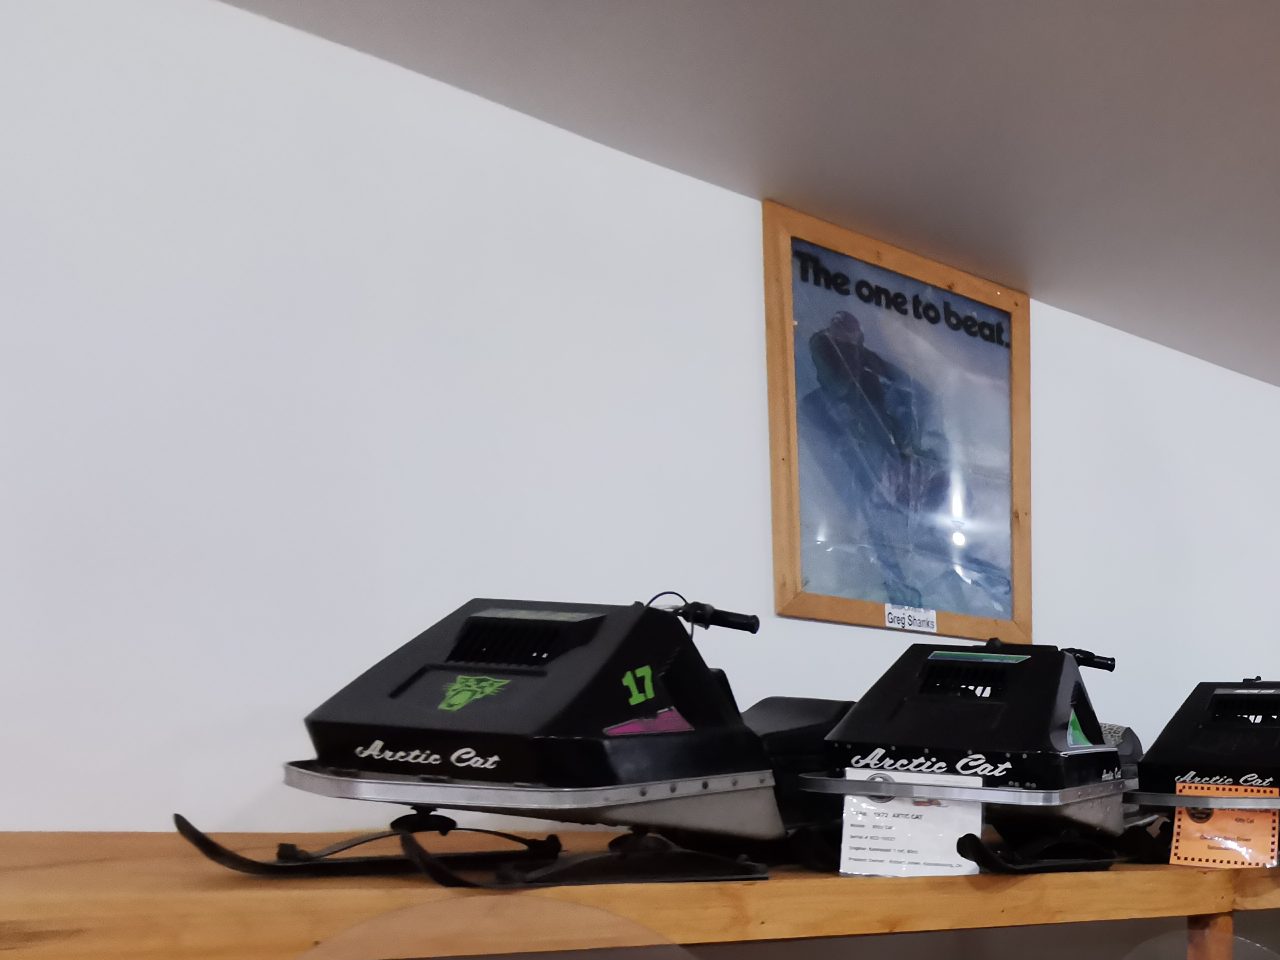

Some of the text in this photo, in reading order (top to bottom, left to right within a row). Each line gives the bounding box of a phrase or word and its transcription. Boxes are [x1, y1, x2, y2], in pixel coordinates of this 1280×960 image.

[793, 249, 1010, 349] The one to beat.
[887, 611, 906, 629] Greg
[622, 665, 655, 706] 17
[356, 740, 501, 770] Arctic Cat
[851, 748, 1013, 777] Arctic Cat
[1175, 770, 1273, 787] Arctic Cat
